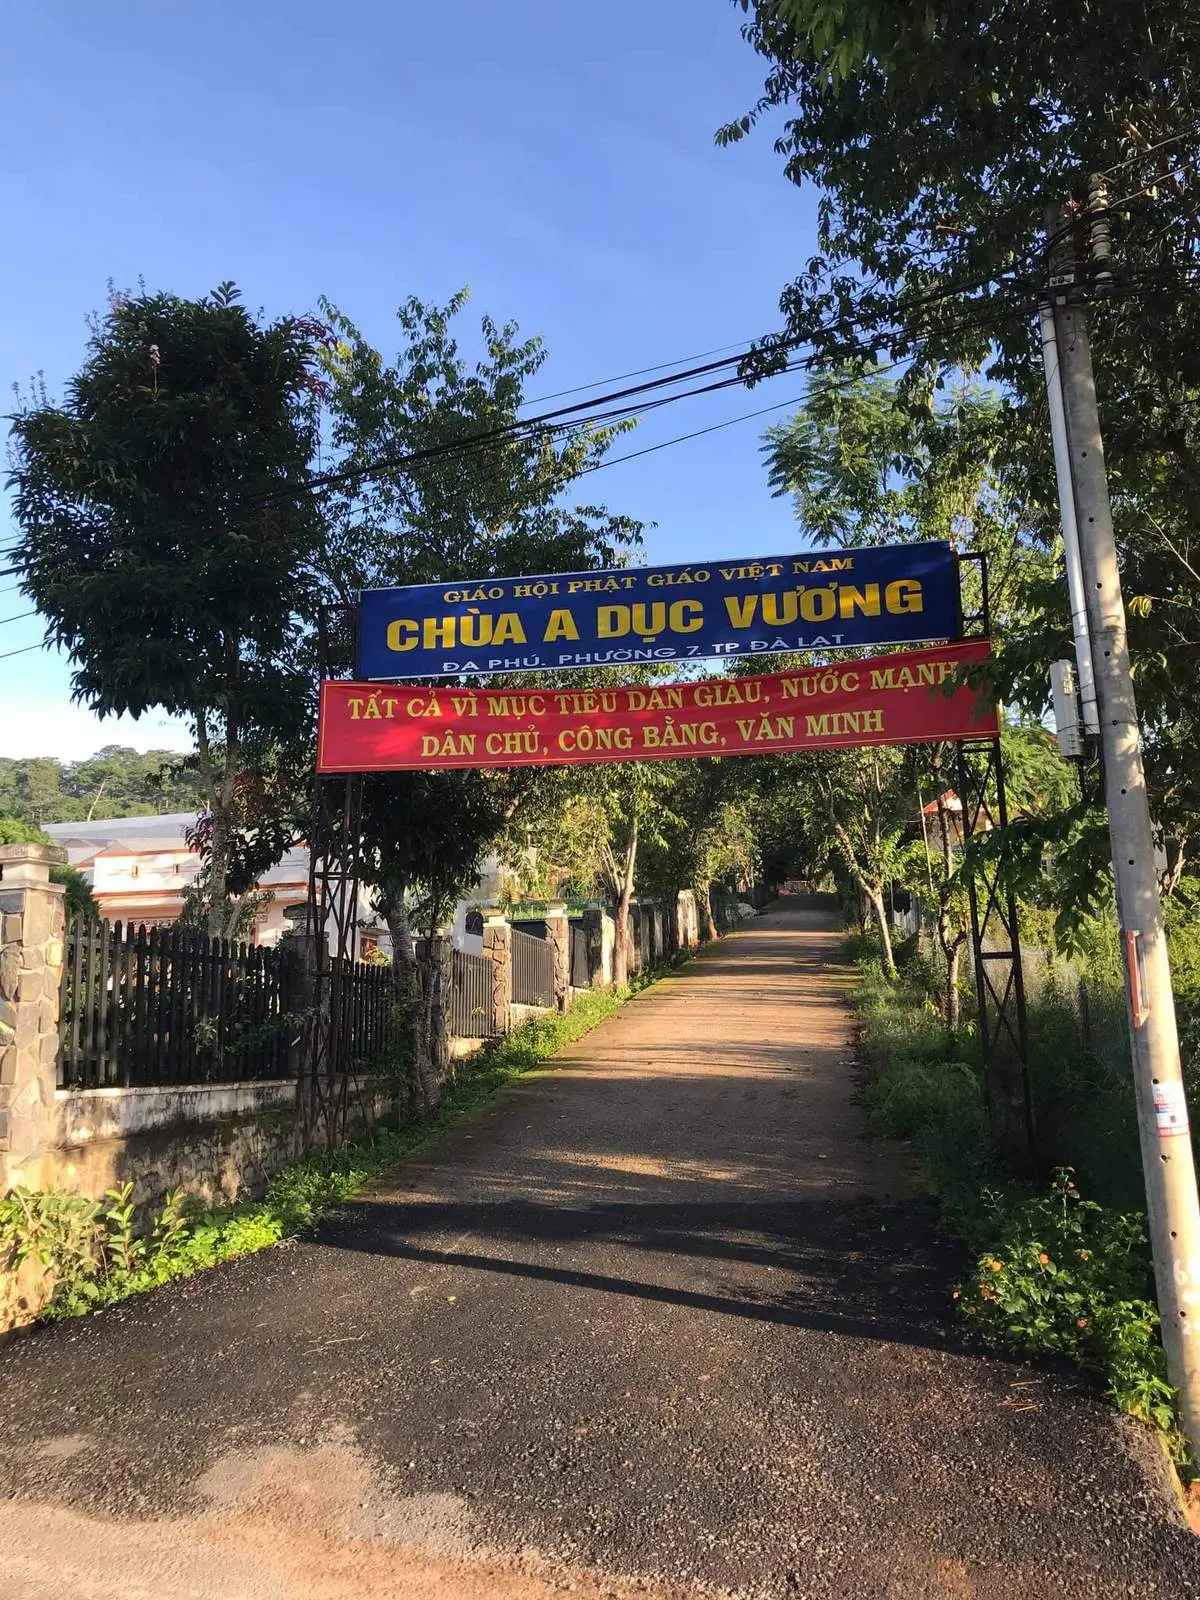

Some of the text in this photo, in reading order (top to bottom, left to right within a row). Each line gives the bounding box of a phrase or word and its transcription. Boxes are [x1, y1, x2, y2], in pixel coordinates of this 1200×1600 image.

[444, 557, 856, 603] GIÁO HỘI PHẬT GIÁO VIỆT NAM
[386, 578, 925, 652] CHÙA A DỤC VƯƠNG
[559, 648, 677, 665] PHƯỜNG
[712, 642, 740, 654] TP
[750, 637, 790, 650] ĐÀ
[348, 689, 399, 720] TẤT
[406, 690, 443, 718] CẢ
[451, 690, 479, 717] VÌ
[486, 695, 547, 720] MỤC
[554, 688, 617, 715] TIÊU
[693, 680, 771, 707] GIÀU,
[780, 668, 860, 700] NƯỚC
[421, 709, 885, 757] DÂN CHỦ, CÔNG BẰNG, VĂN MINH
